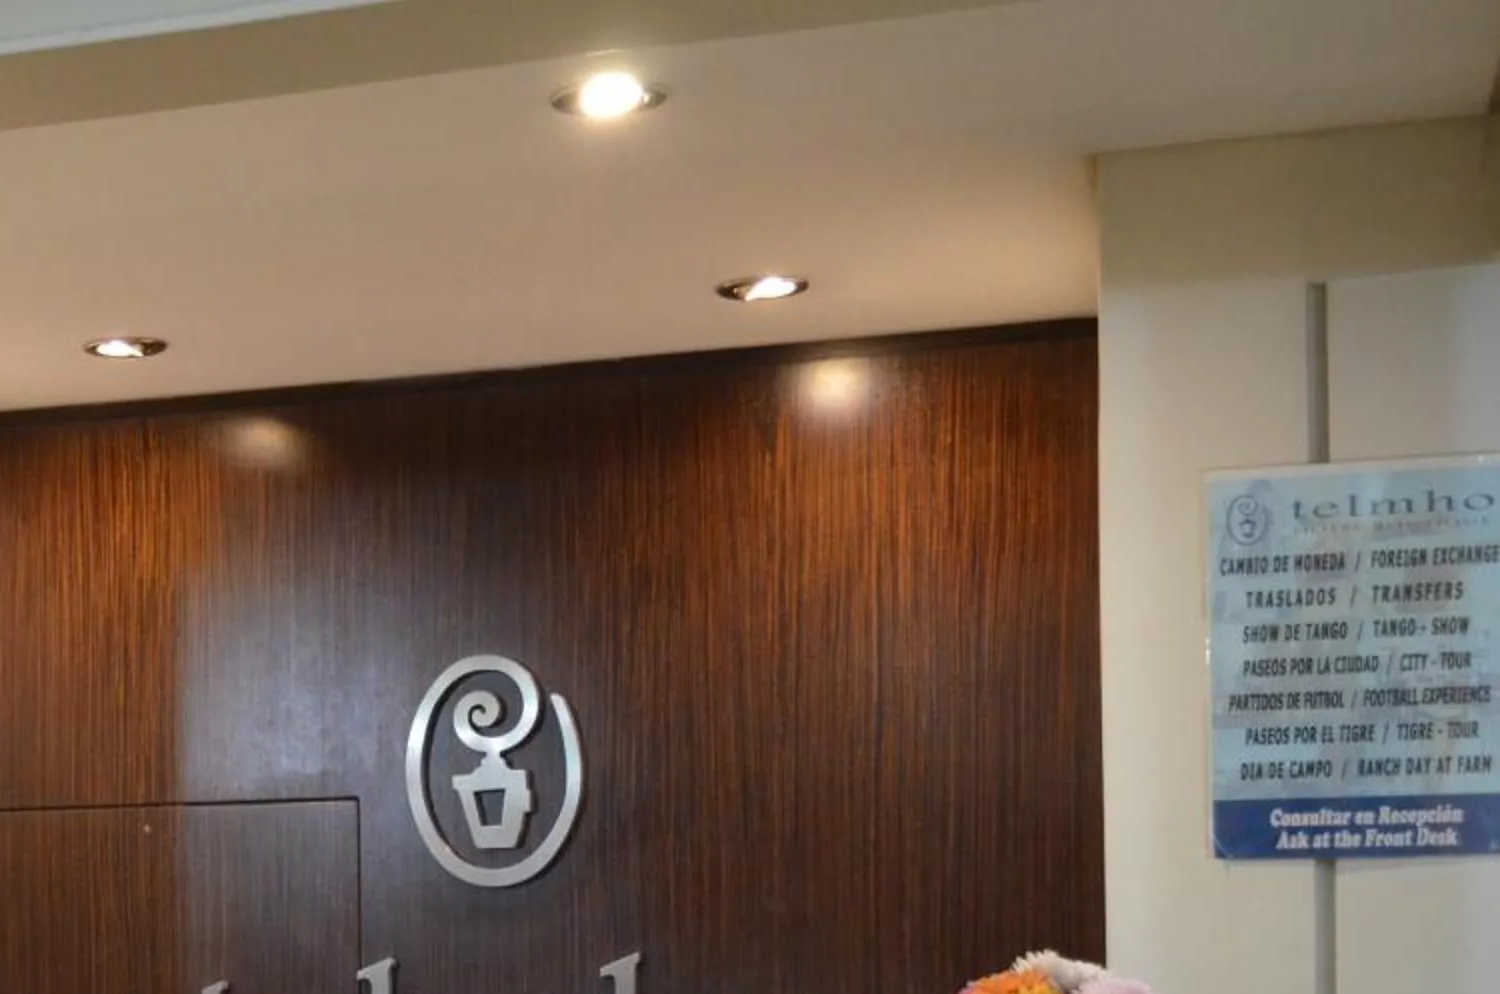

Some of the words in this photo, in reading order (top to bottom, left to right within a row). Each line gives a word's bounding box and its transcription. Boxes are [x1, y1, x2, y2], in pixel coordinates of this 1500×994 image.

[1293, 489, 1496, 519] telmho
[1220, 556, 1269, 576] CAMBIO
[1273, 555, 1289, 574] DE
[1293, 551, 1346, 573] MONEDA
[1371, 548, 1427, 569] FOREIGN
[1433, 544, 1500, 566] EXCHANGE
[1246, 586, 1336, 609] TRASLADOS
[1372, 581, 1464, 604] TRANSFERS
[1243, 623, 1279, 643] SHOW
[1284, 623, 1301, 641] DE
[1306, 621, 1348, 641] TANGO
[1373, 618, 1416, 637] TANGO
[1431, 616, 1470, 636] SHOW
[1243, 657, 1287, 678] PASEOS
[1290, 657, 1314, 675] POR
[1317, 656, 1331, 675] LA
[1334, 655, 1379, 675] CIUDAD
[1400, 653, 1428, 672] CITY
[1440, 651, 1472, 670] TOUR
[1229, 691, 1284, 712] PARTIDOS
[1287, 691, 1301, 709] DE
[1303, 689, 1345, 709] FUTBOL
[1363, 687, 1418, 708] FOOTBALL
[1421, 685, 1492, 706] EXPERIENCE
[1245, 726, 1290, 746] PASEOS
[1294, 726, 1317, 744] POR
[1321, 725, 1334, 744] EL
[1339, 723, 1375, 743] TIGRE
[1397, 721, 1434, 742] TIGRE
[1447, 720, 1480, 740] TOUR
[1240, 761, 1263, 781] DIA
[1267, 761, 1285, 779] DE
[1290, 759, 1333, 779] CAMPO
[1358, 757, 1401, 777] RANCH
[1405, 756, 1431, 774] DAY
[1435, 755, 1453, 774] AT
[1457, 753, 1492, 774] FARM
[1270, 807, 1351, 827] Consultar
[1354, 811, 1376, 825] en
[1378, 804, 1464, 826] Recepción
[1276, 831, 1309, 849] Ask
[1312, 833, 1332, 848] at
[1334, 830, 1361, 849] the
[1364, 829, 1414, 847] Front
[1416, 827, 1459, 846] Desk
